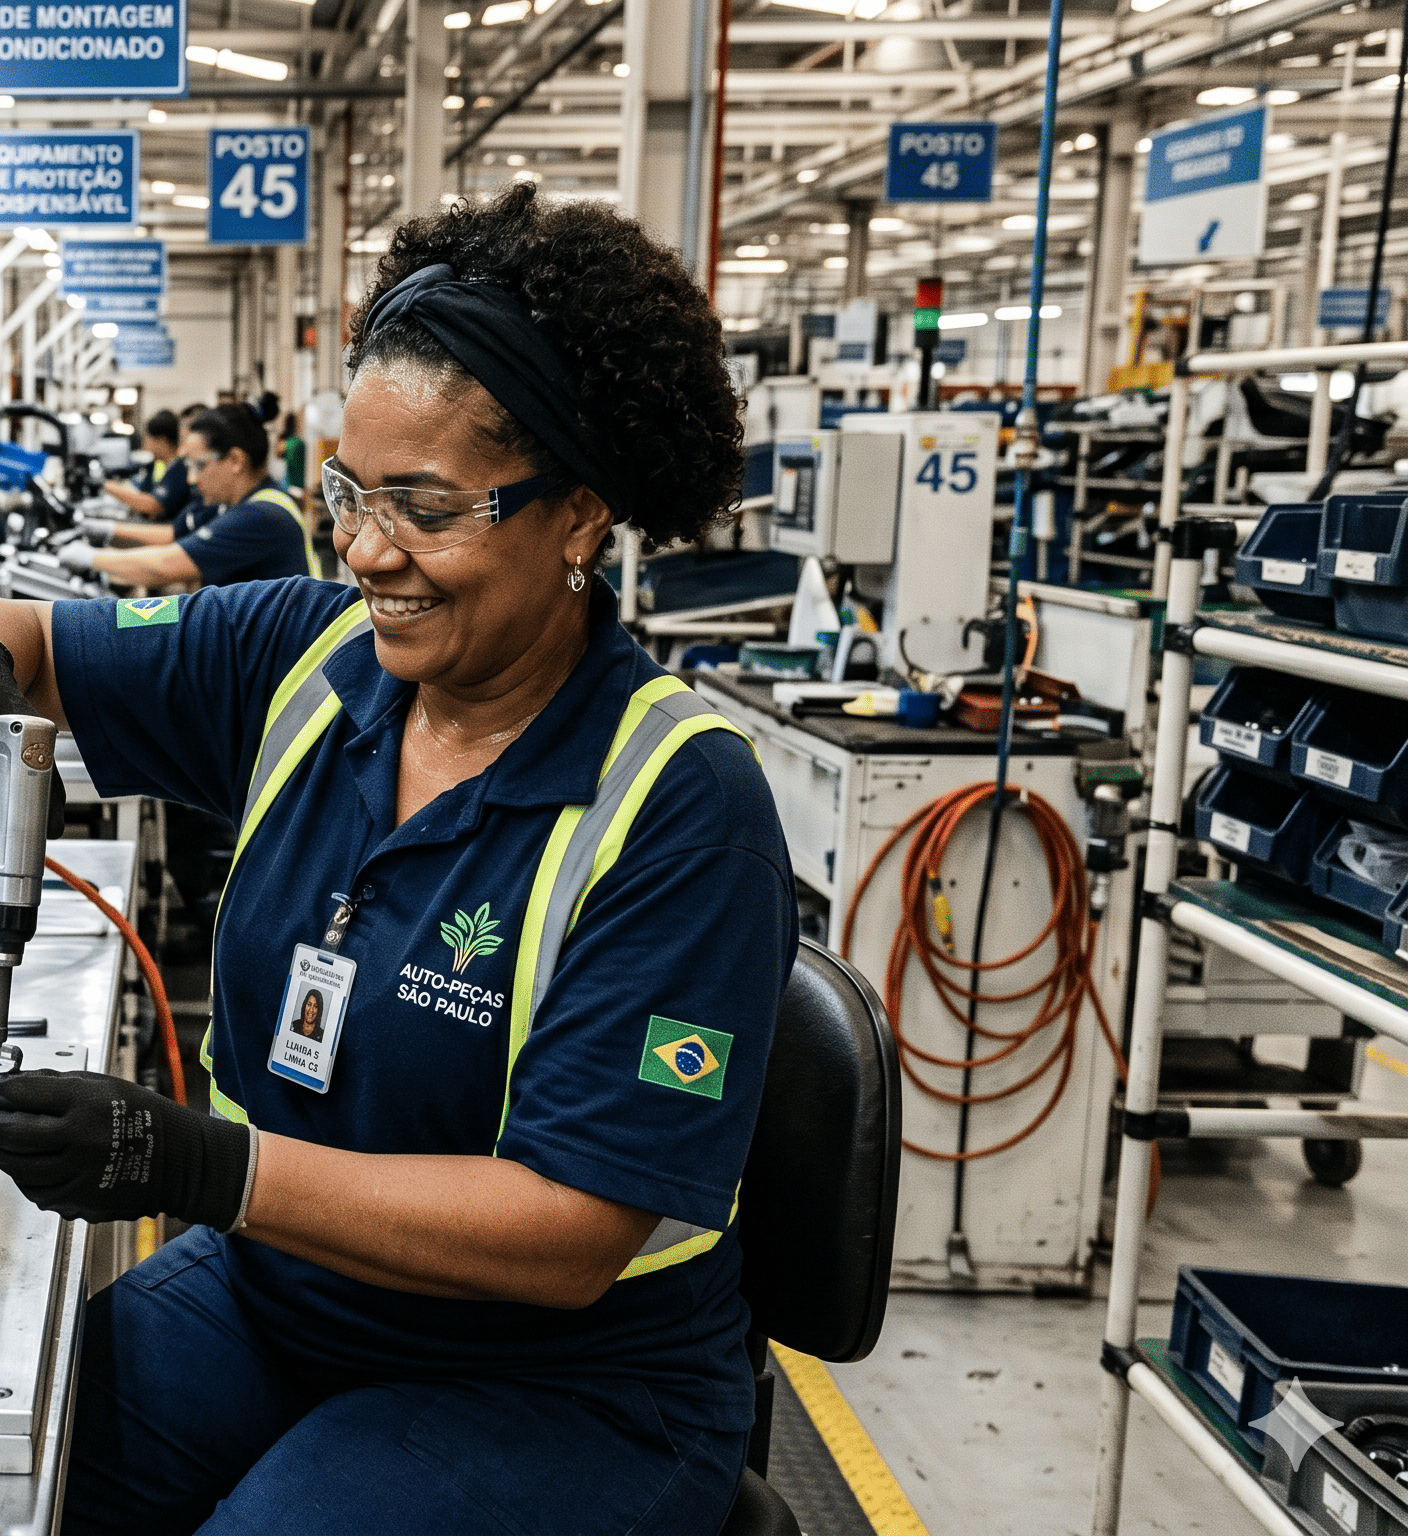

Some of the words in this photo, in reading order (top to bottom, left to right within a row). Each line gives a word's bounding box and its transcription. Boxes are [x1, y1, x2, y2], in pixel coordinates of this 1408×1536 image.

[36, 5, 174, 29] MONTAGEM
[215, 134, 305, 159] POSTO
[898, 132, 986, 157] POSTO
[14, 164, 124, 192] PROTEÇÃO
[219, 163, 299, 219] 45
[920, 161, 960, 191] 45
[916, 452, 978, 494] 45
[399, 963, 505, 1008] AUTO-PEÇAS
[397, 983, 431, 1007] SÃO
[434, 997, 492, 1027] PAULO
